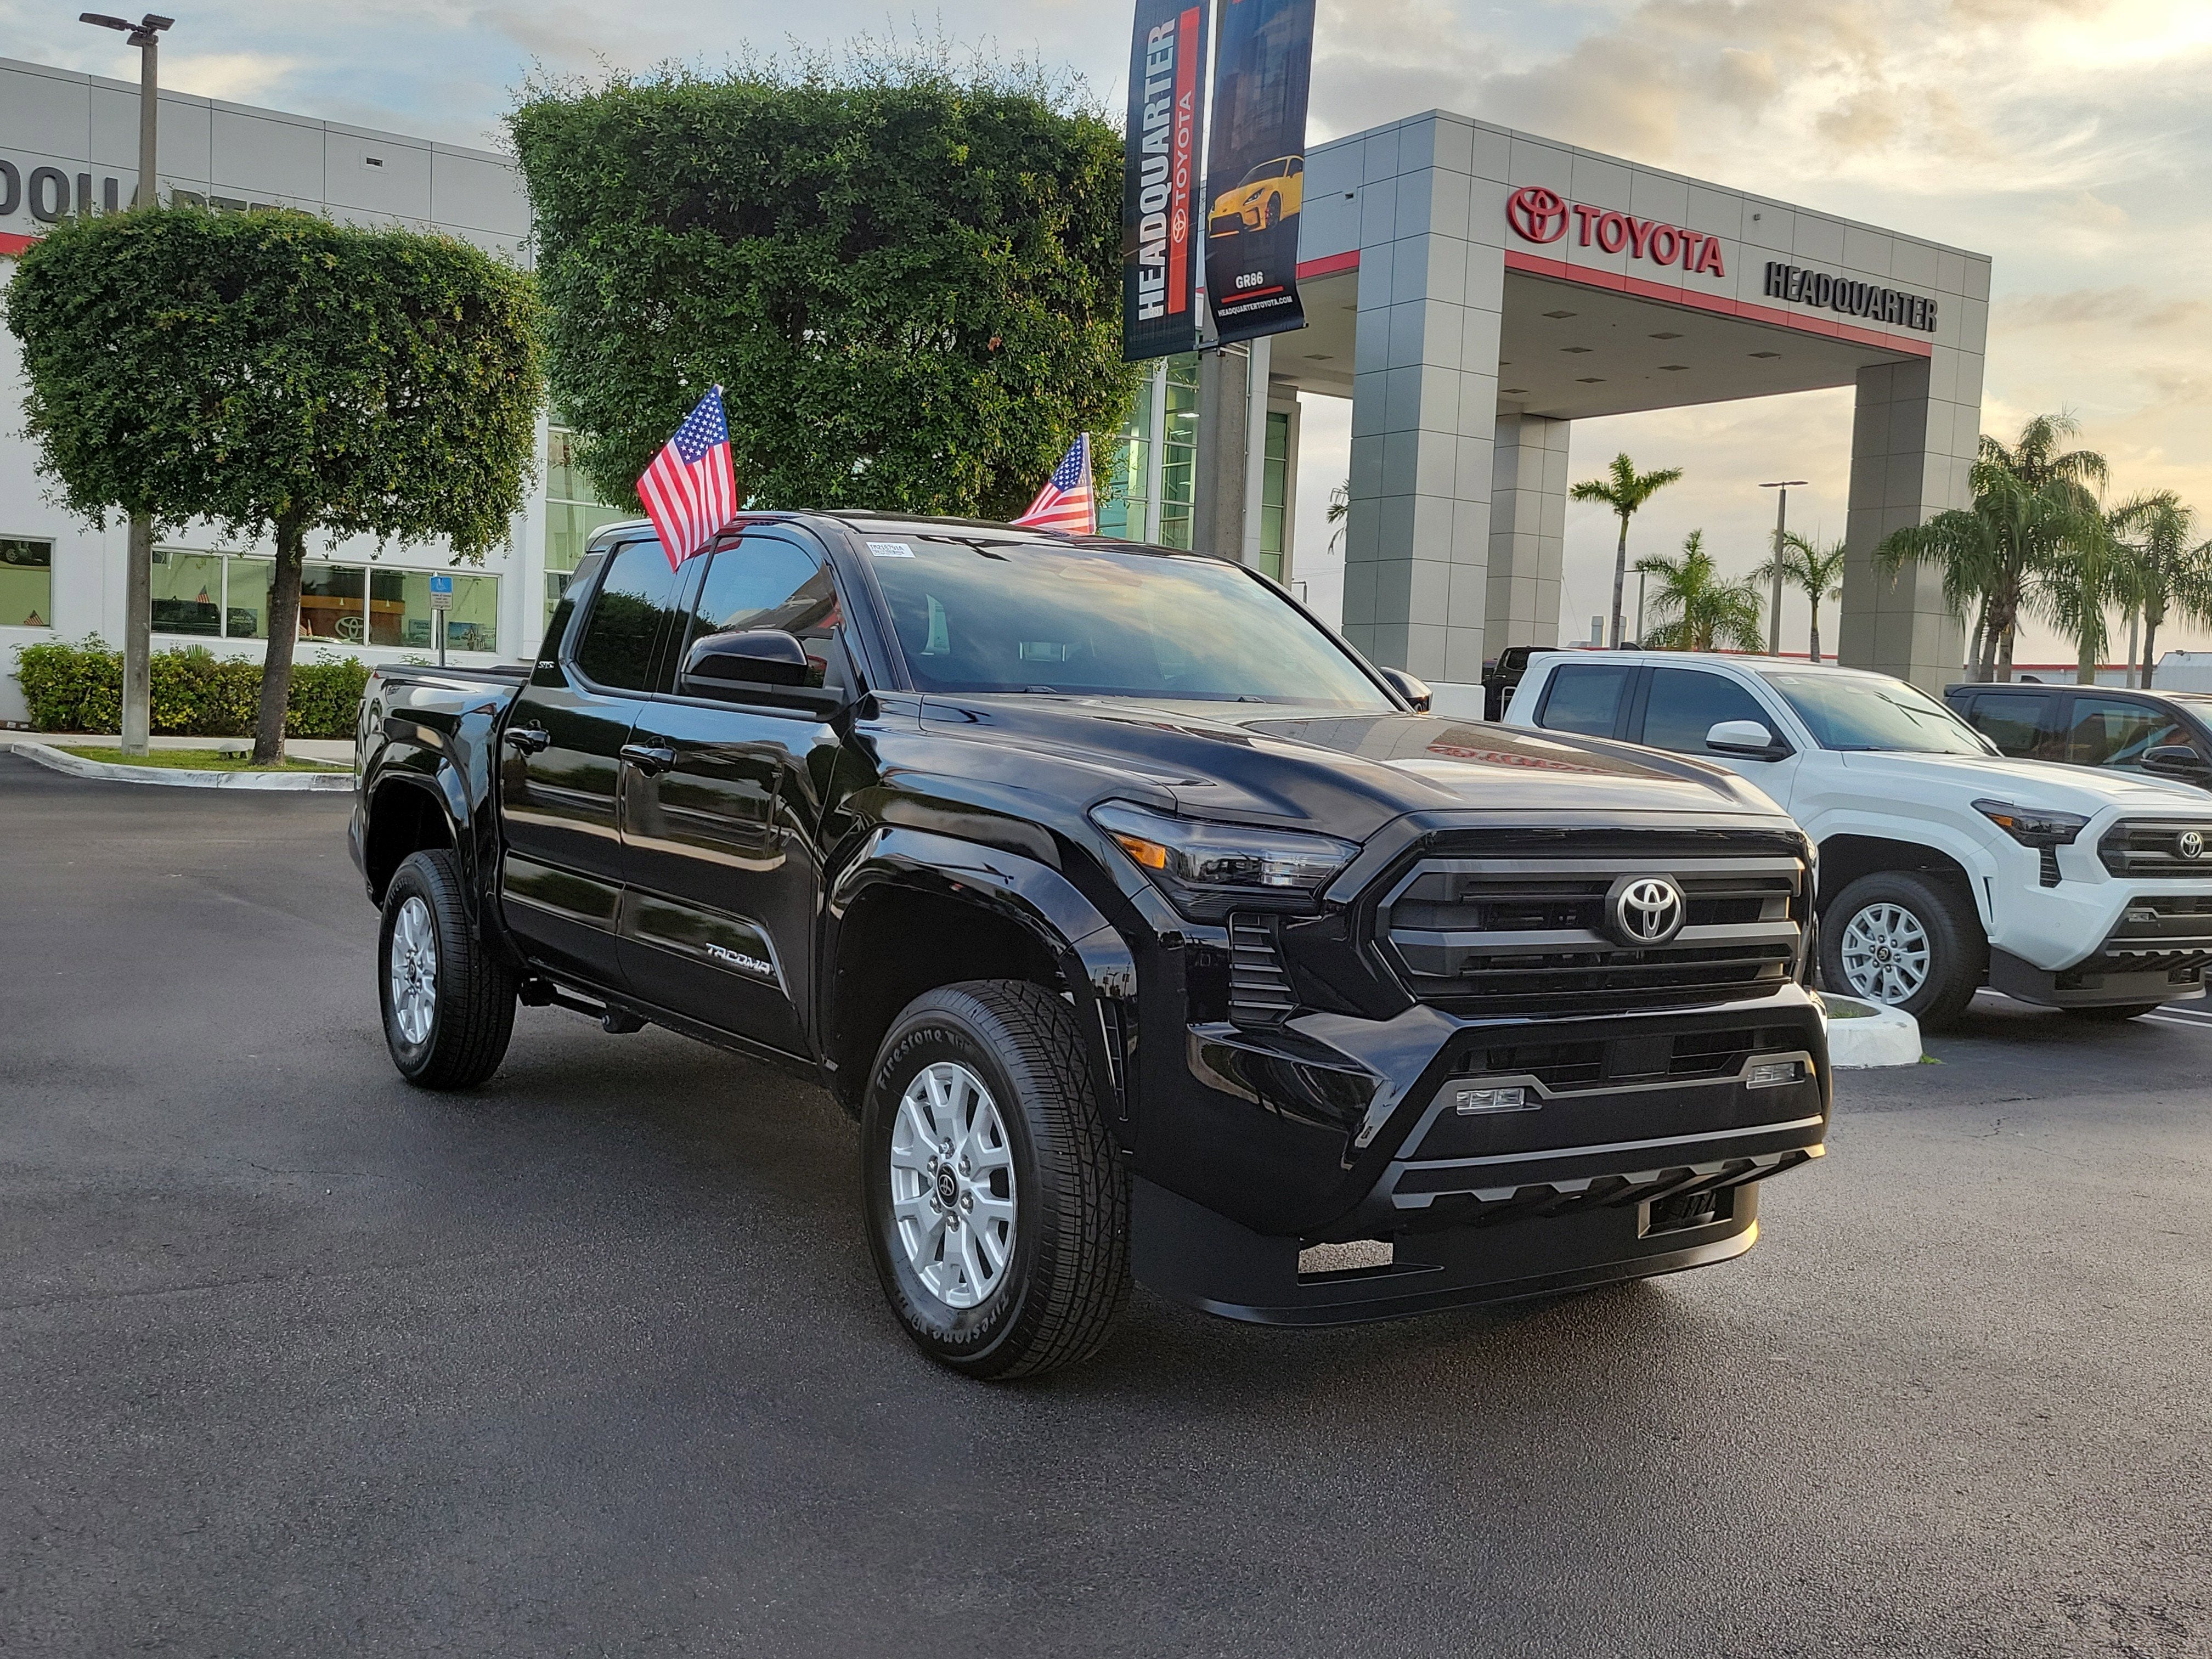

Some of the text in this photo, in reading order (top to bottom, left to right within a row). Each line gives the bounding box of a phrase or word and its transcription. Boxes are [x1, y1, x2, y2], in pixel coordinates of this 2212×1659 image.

[1139, 18, 1176, 320] HEADQUARTER
[1175, 91, 1192, 206] TOYOTA
[1574, 204, 1725, 277] TOYOTA
[1218, 296, 1293, 317] HEADQUARTERTOYOTA.COM
[1235, 271, 1263, 289] GR86
[1766, 261, 1938, 332] HEADQUARTER
[706, 943, 769, 975] TACOMA
[877, 1029, 943, 1091] Firestone
